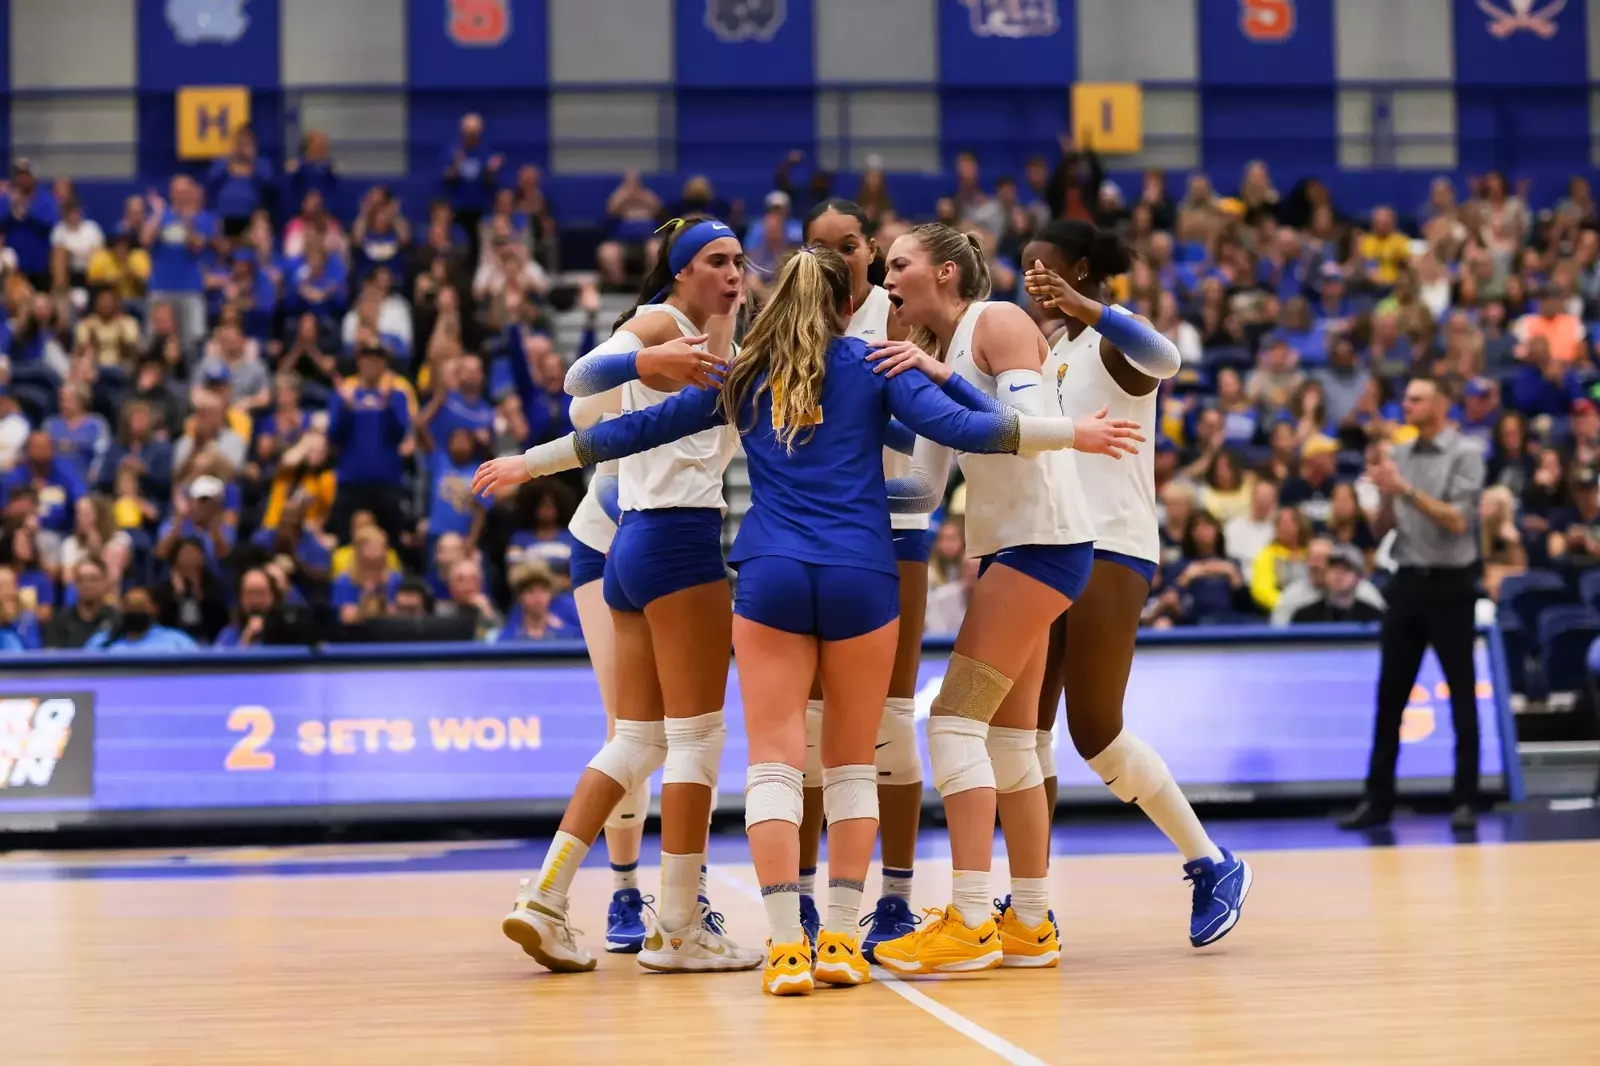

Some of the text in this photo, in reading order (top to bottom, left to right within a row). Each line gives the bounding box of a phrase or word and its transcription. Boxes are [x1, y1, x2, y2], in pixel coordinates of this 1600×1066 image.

[197, 105, 230, 140] H
[225, 706, 542, 770] 2 SETS WON
